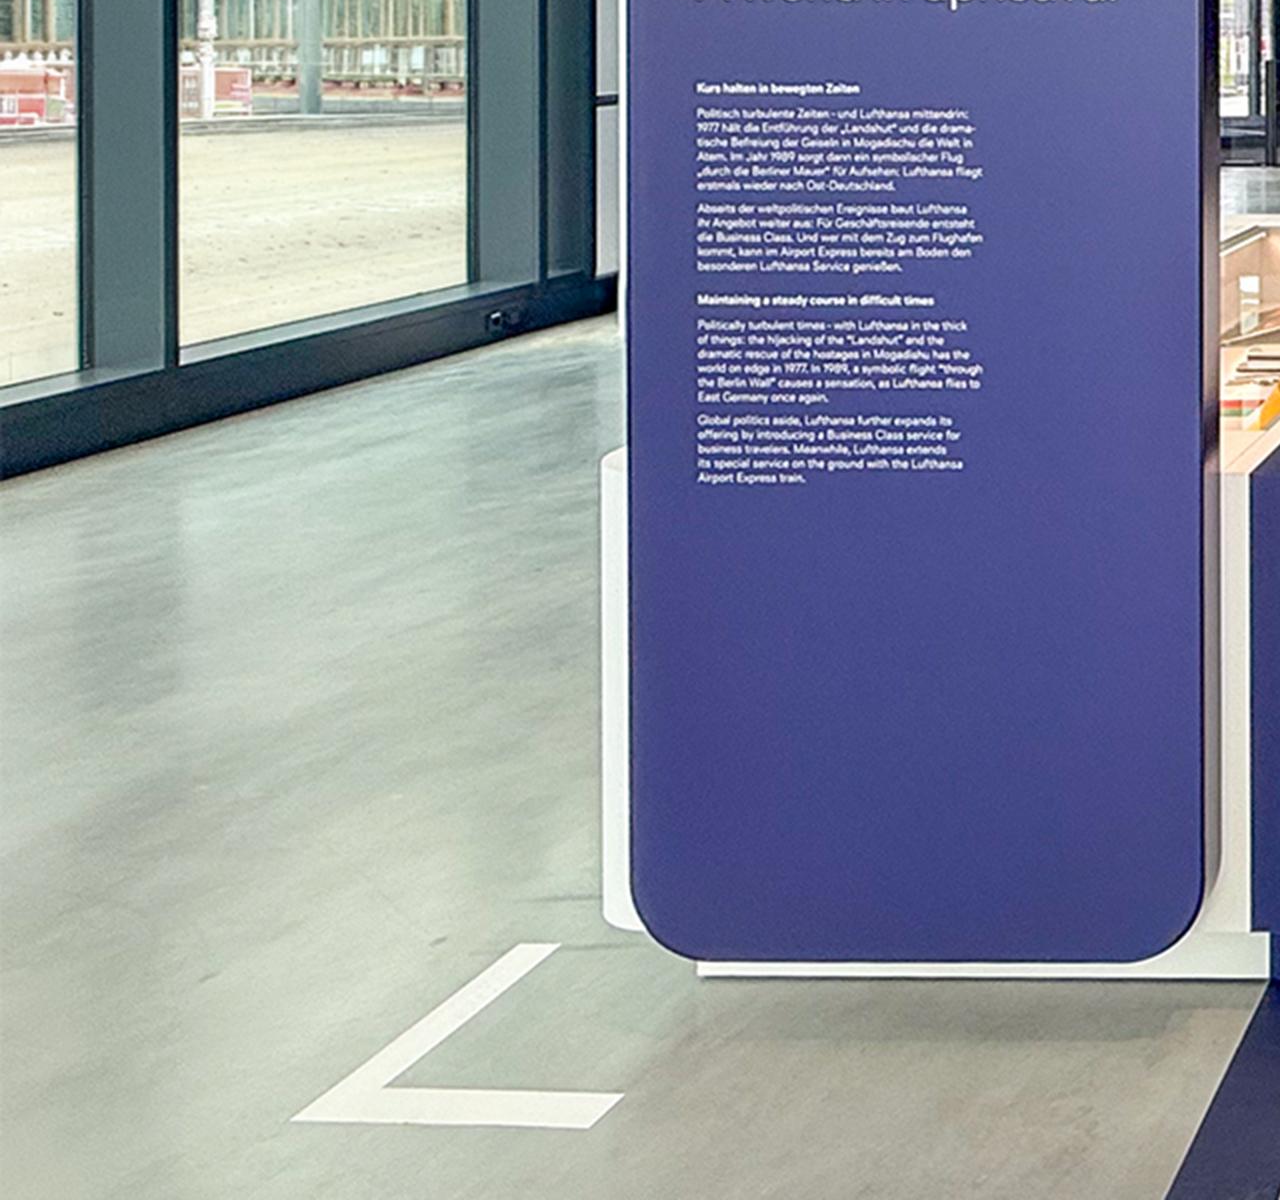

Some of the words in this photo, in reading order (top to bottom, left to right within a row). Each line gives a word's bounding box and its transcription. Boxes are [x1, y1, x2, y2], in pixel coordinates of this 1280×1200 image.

[696, 82, 722, 95] Kurs
[722, 82, 757, 94] halten
[770, 82, 825, 97] bewegten
[825, 82, 861, 95] Zeiten
[696, 107, 741, 119] Politisch
[741, 108, 796, 119] turbulente
[796, 107, 830, 119] Zeiten
[836, 108, 858, 120] und
[859, 108, 911, 120] Lufthansa
[721, 122, 741, 133] hält
[761, 121, 819, 136] Entführung
[820, 122, 839, 134] der
[898, 123, 920, 134] und
[696, 137, 729, 148] tische
[730, 135, 780, 150] Befreiung
[800, 136, 840, 149] Geiseln
[935, 137, 961, 149] Welt
[745, 151, 769, 163] Jahr
[797, 152, 825, 165] sorgt
[825, 151, 852, 163] dann
[872, 151, 939, 164] symbolischer
[940, 151, 964, 165] Flug
[751, 165, 791, 177] Berliner
[902, 165, 954, 178] Lufthansa
[955, 166, 983, 180] fliegt
[697, 180, 741, 191] erstmals
[742, 180, 778, 191] wieder
[779, 180, 805, 191] nach
[697, 203, 737, 214] Abseits
[737, 203, 756, 214] der
[757, 203, 834, 216] weltpolitischen
[836, 202, 889, 217] Ereignisse
[890, 203, 914, 215] baut
[916, 203, 968, 215] Lufthansa
[712, 217, 757, 231] Angebot
[758, 218, 791, 229] weiter
[834, 217, 931, 229] Geschäftsreisende
[931, 218, 975, 230] entsteht
[715, 231, 762, 243] Business
[796, 232, 819, 243] Und
[820, 234, 840, 243] wer
[860, 232, 885, 244] dem
[886, 231, 907, 246] Zug
[908, 234, 930, 244] zum
[931, 232, 984, 246] Flughafen
[738, 246, 763, 257] kann
[779, 246, 816, 259] Airport
[817, 245, 858, 259] Express
[859, 246, 896, 258] bereits
[915, 246, 950, 258] Boden
[950, 247, 972, 258] den
[697, 260, 758, 272] besonderen
[759, 260, 811, 272] Lufthansa
[812, 259, 851, 273] Service
[697, 293, 762, 308] Maintaining
[771, 294, 809, 308] steady
[808, 296, 846, 306] course
[859, 294, 902, 307] difficult
[903, 295, 935, 307] times
[697, 319, 746, 333] Politically
[747, 320, 795, 331] turbulent
[796, 321, 826, 331] times
[833, 320, 857, 331] with
[857, 320, 909, 332] Lufthansa
[941, 320, 967, 332] thick
[747, 334, 766, 345] the
[766, 334, 813, 348] hijacking
[826, 335, 845, 346] the
[905, 334, 925, 346] and
[926, 335, 945, 346] the
[697, 349, 742, 360] dramatic
[744, 350, 779, 360] rescue
[812, 349, 860, 362] hostages
[873, 348, 931, 363] Mogadishu
[932, 349, 951, 361] has
[697, 363, 727, 374] world
[743, 363, 771, 376] edge
[861, 363, 907, 376] symbolic
[908, 363, 937, 377] flight
[717, 376, 748, 389] Berlin
[777, 379, 814, 389] causes
[892, 377, 944, 389] Lufthansa
[945, 377, 968, 389] flies
[697, 390, 721, 403] East
[722, 390, 769, 405] Germany
[770, 393, 797, 403] once
[697, 413, 731, 426] Global
[732, 415, 770, 427] politics
[804, 414, 856, 426] Lufthansa
[857, 415, 892, 426] further
[893, 416, 937, 428] expands
[697, 429, 739, 442] offering
[756, 429, 816, 443] introducing
[826, 428, 873, 441] Business
[874, 428, 904, 441] Class
[906, 431, 944, 441] service
[697, 443, 743, 455] business
[853, 443, 905, 455] Lufthansa
[905, 444, 947, 456] extends
[713, 458, 751, 470] special
[752, 459, 790, 469] service
[807, 458, 825, 469] the
[827, 458, 865, 472] ground
[866, 458, 890, 469] with
[891, 459, 910, 470] the
[910, 458, 964, 470] Lufthansa
[697, 472, 734, 485] Airport
[736, 471, 777, 485] Express
